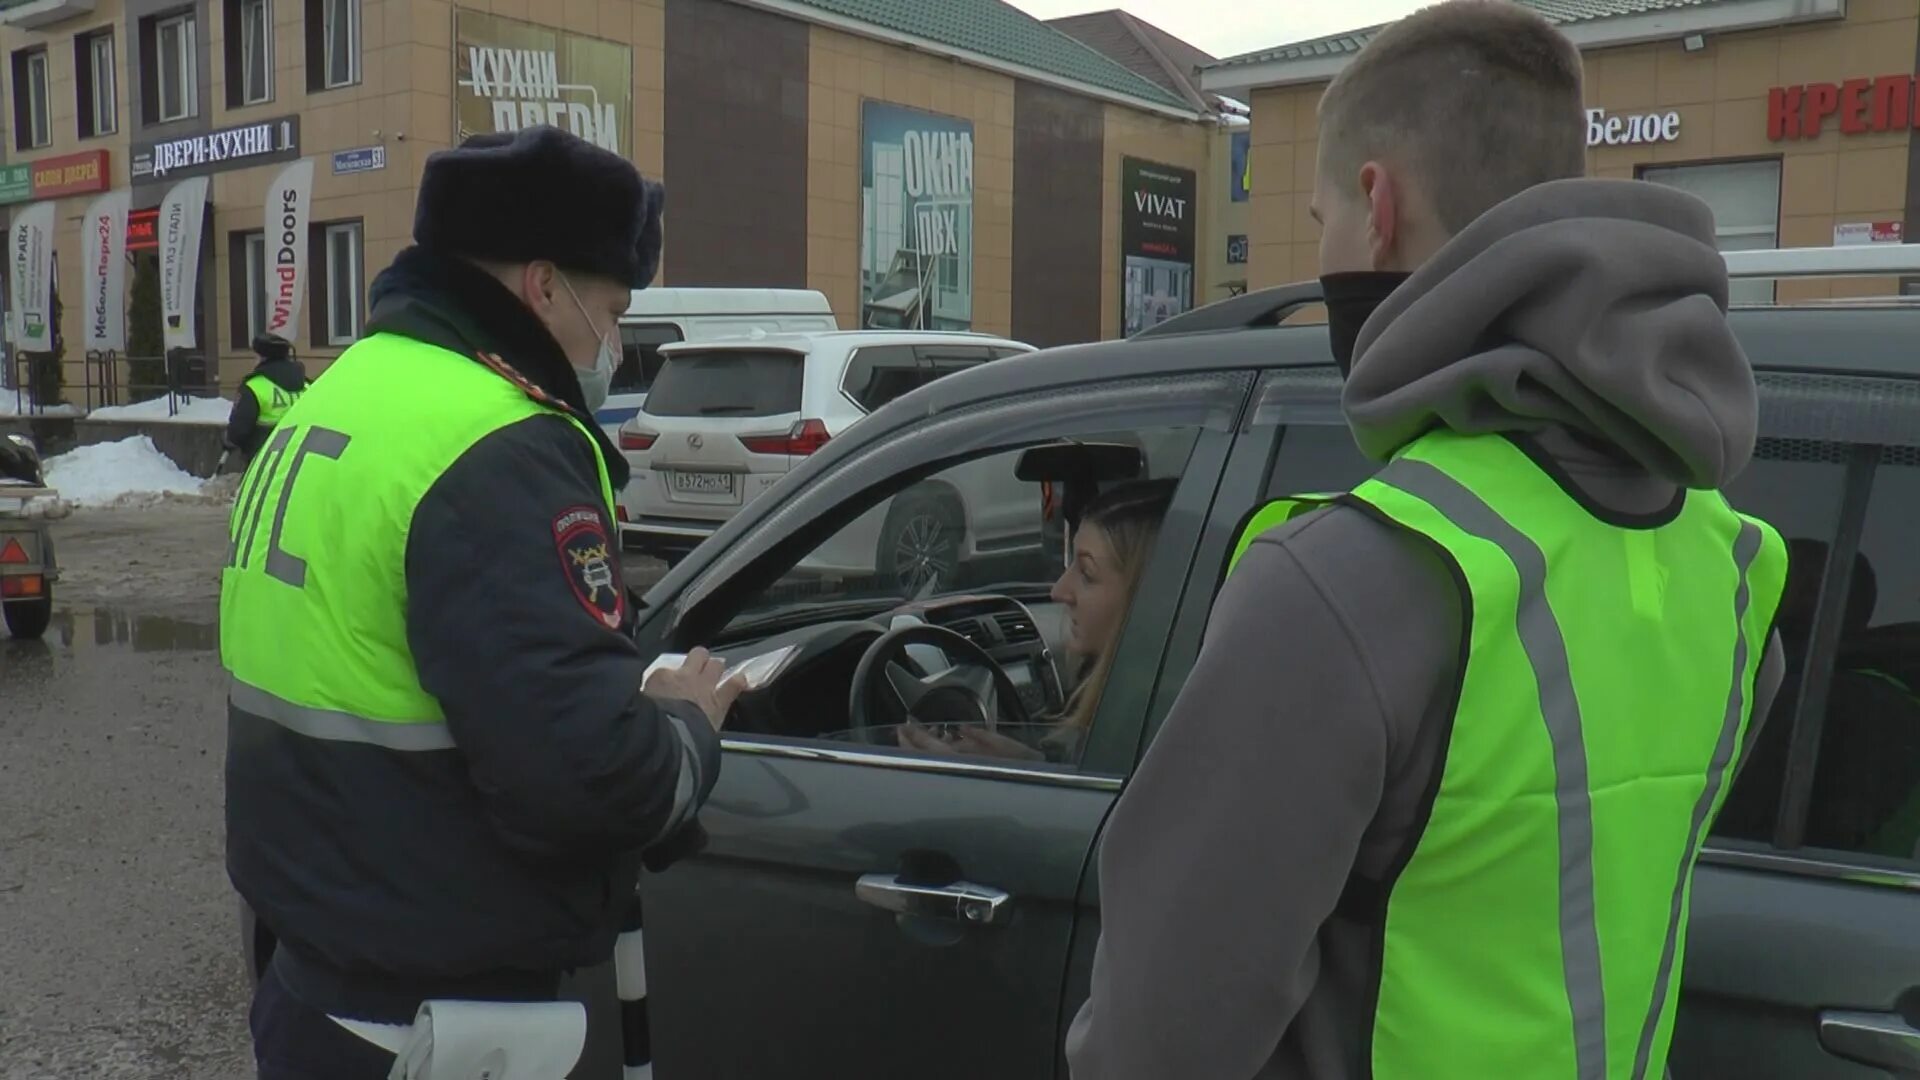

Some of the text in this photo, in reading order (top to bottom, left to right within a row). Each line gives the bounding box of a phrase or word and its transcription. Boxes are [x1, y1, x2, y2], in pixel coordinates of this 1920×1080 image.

[470, 47, 559, 99] КУХНИ
[1586, 108, 1680, 146] Белое
[1767, 74, 1920, 142] КРЕП
[154, 124, 271, 177] ДВЕРИ-КУХНИ
[904, 130, 973, 197] ОКНА
[1134, 191, 1186, 219] VIVAT
[918, 209, 957, 256] ПВХ
[269, 189, 297, 332] WindDoors
